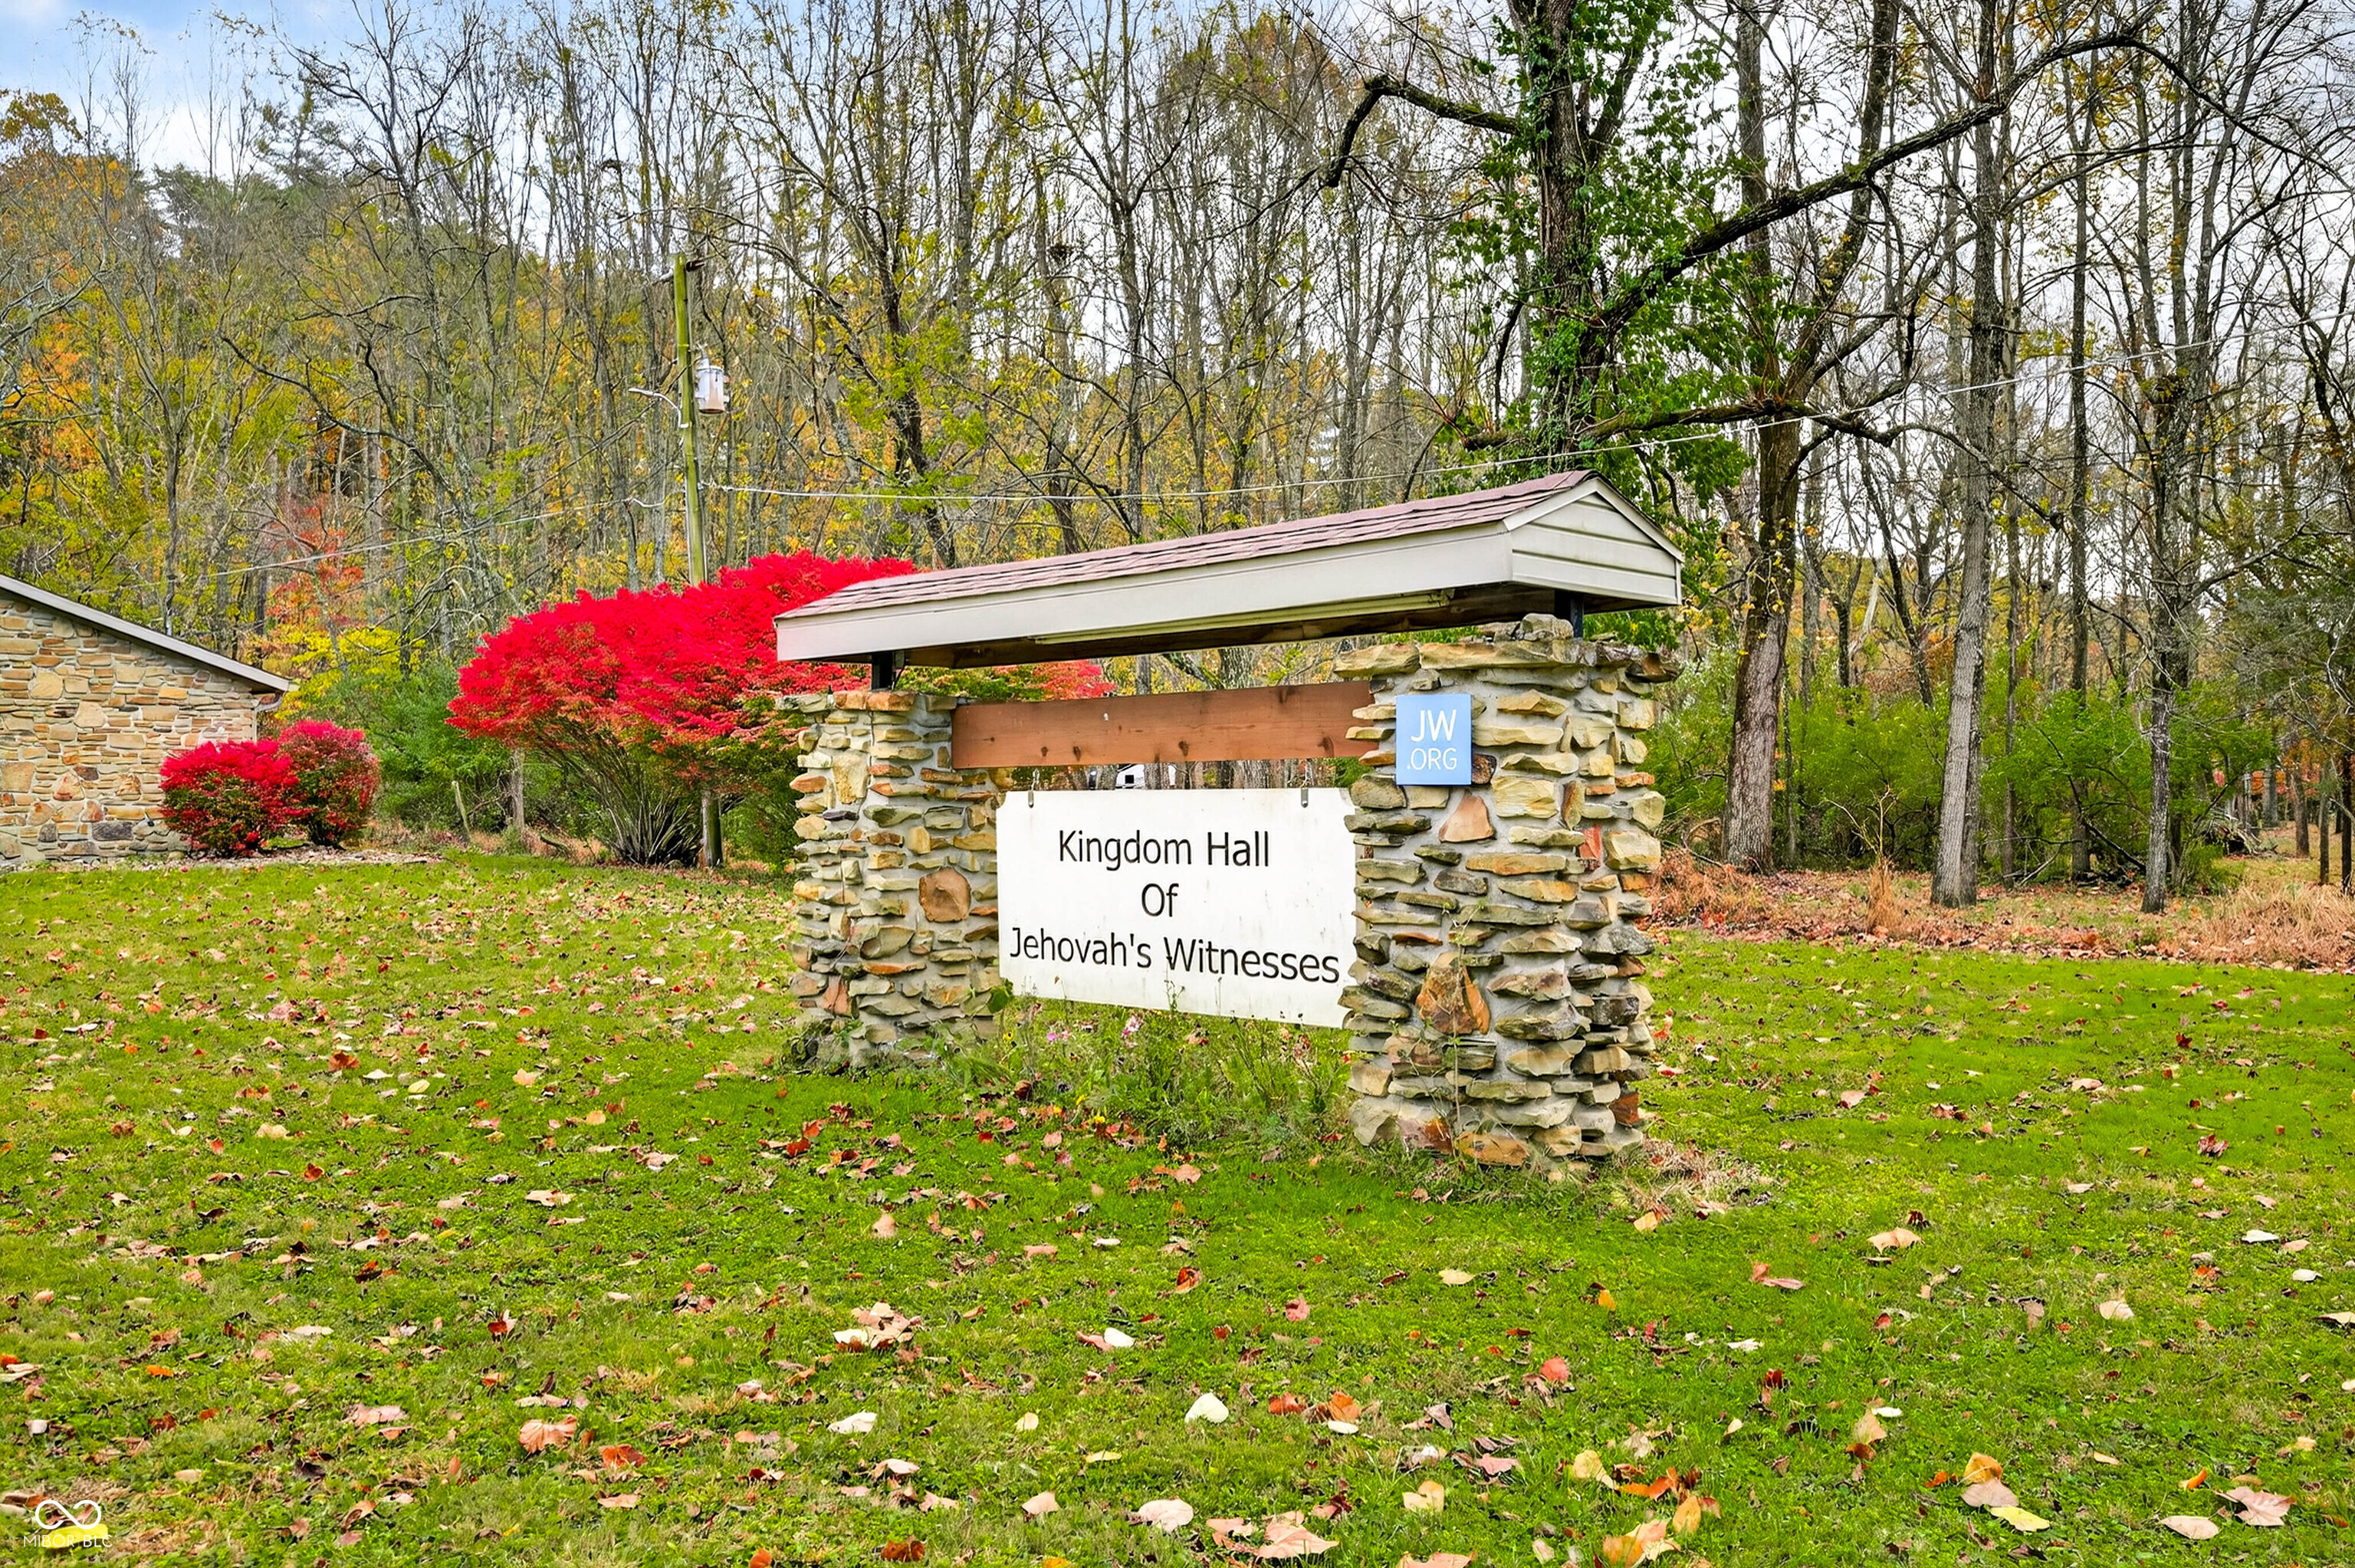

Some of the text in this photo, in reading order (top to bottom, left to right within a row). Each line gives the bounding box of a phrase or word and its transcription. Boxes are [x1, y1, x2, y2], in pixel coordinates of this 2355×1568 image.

[1411, 709, 1457, 742] JW
[1407, 747, 1457, 770] .ORG
[1059, 830, 1269, 871] Kingdom Hall
[1141, 884, 1180, 917] Of
[1010, 927, 1340, 983] Jehovah's Witnesses
